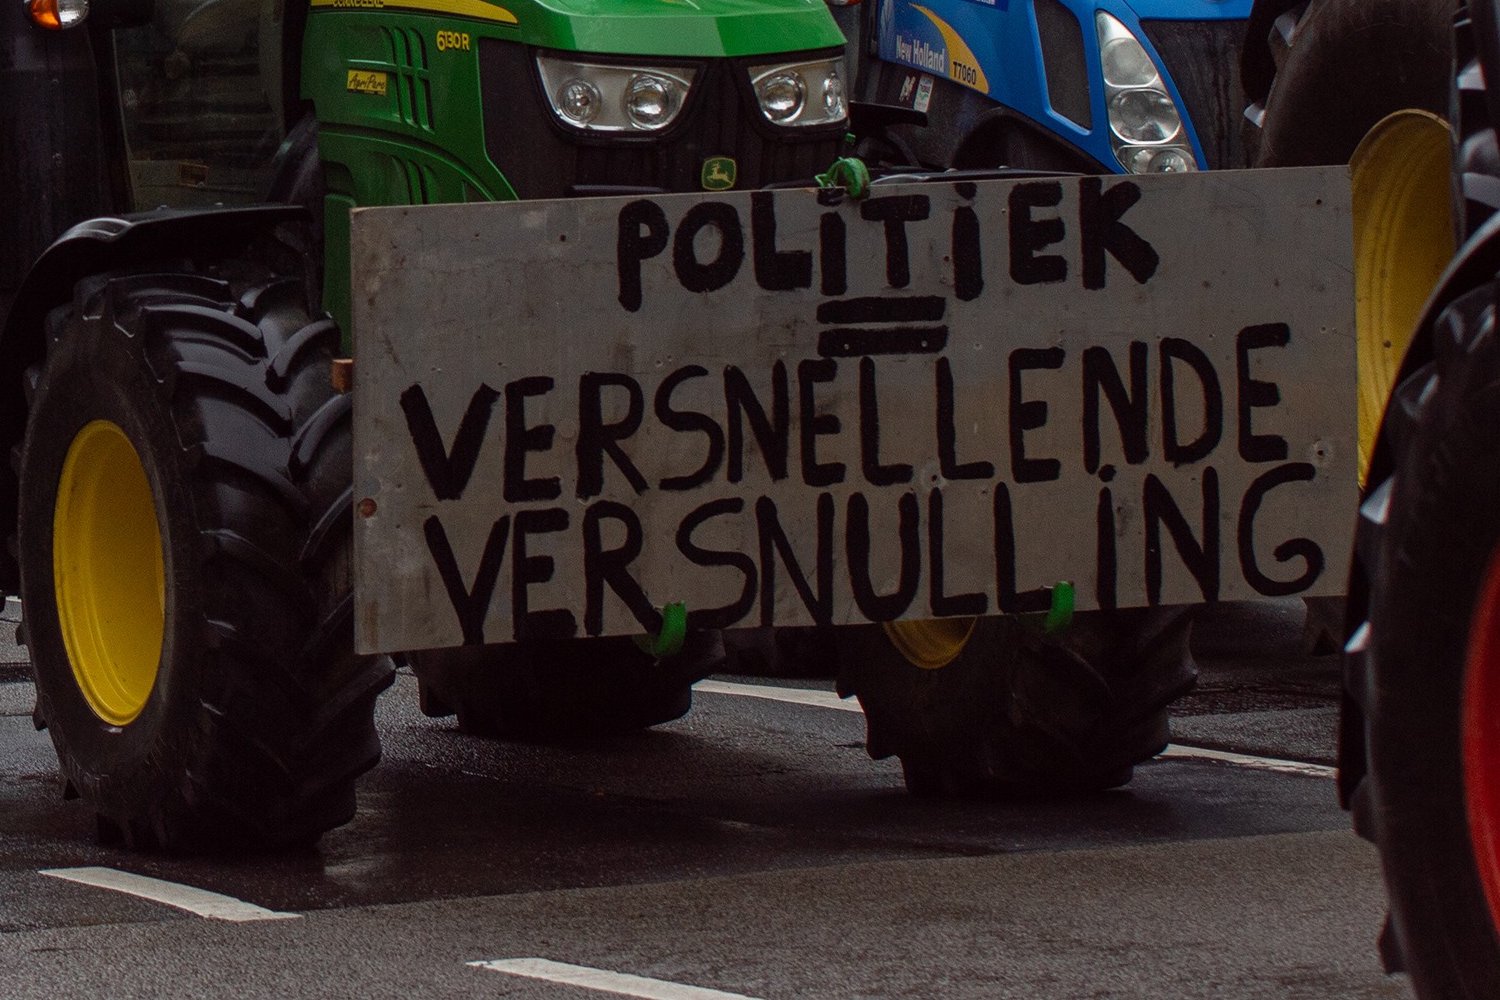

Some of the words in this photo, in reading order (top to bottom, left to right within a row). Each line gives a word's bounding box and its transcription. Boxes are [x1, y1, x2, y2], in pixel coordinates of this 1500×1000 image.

[896, 34, 913, 63] New
[913, 39, 946, 73] Holland
[953, 61, 977, 86] T7060
[400, 322, 1290, 503] VERSNELLENDE
